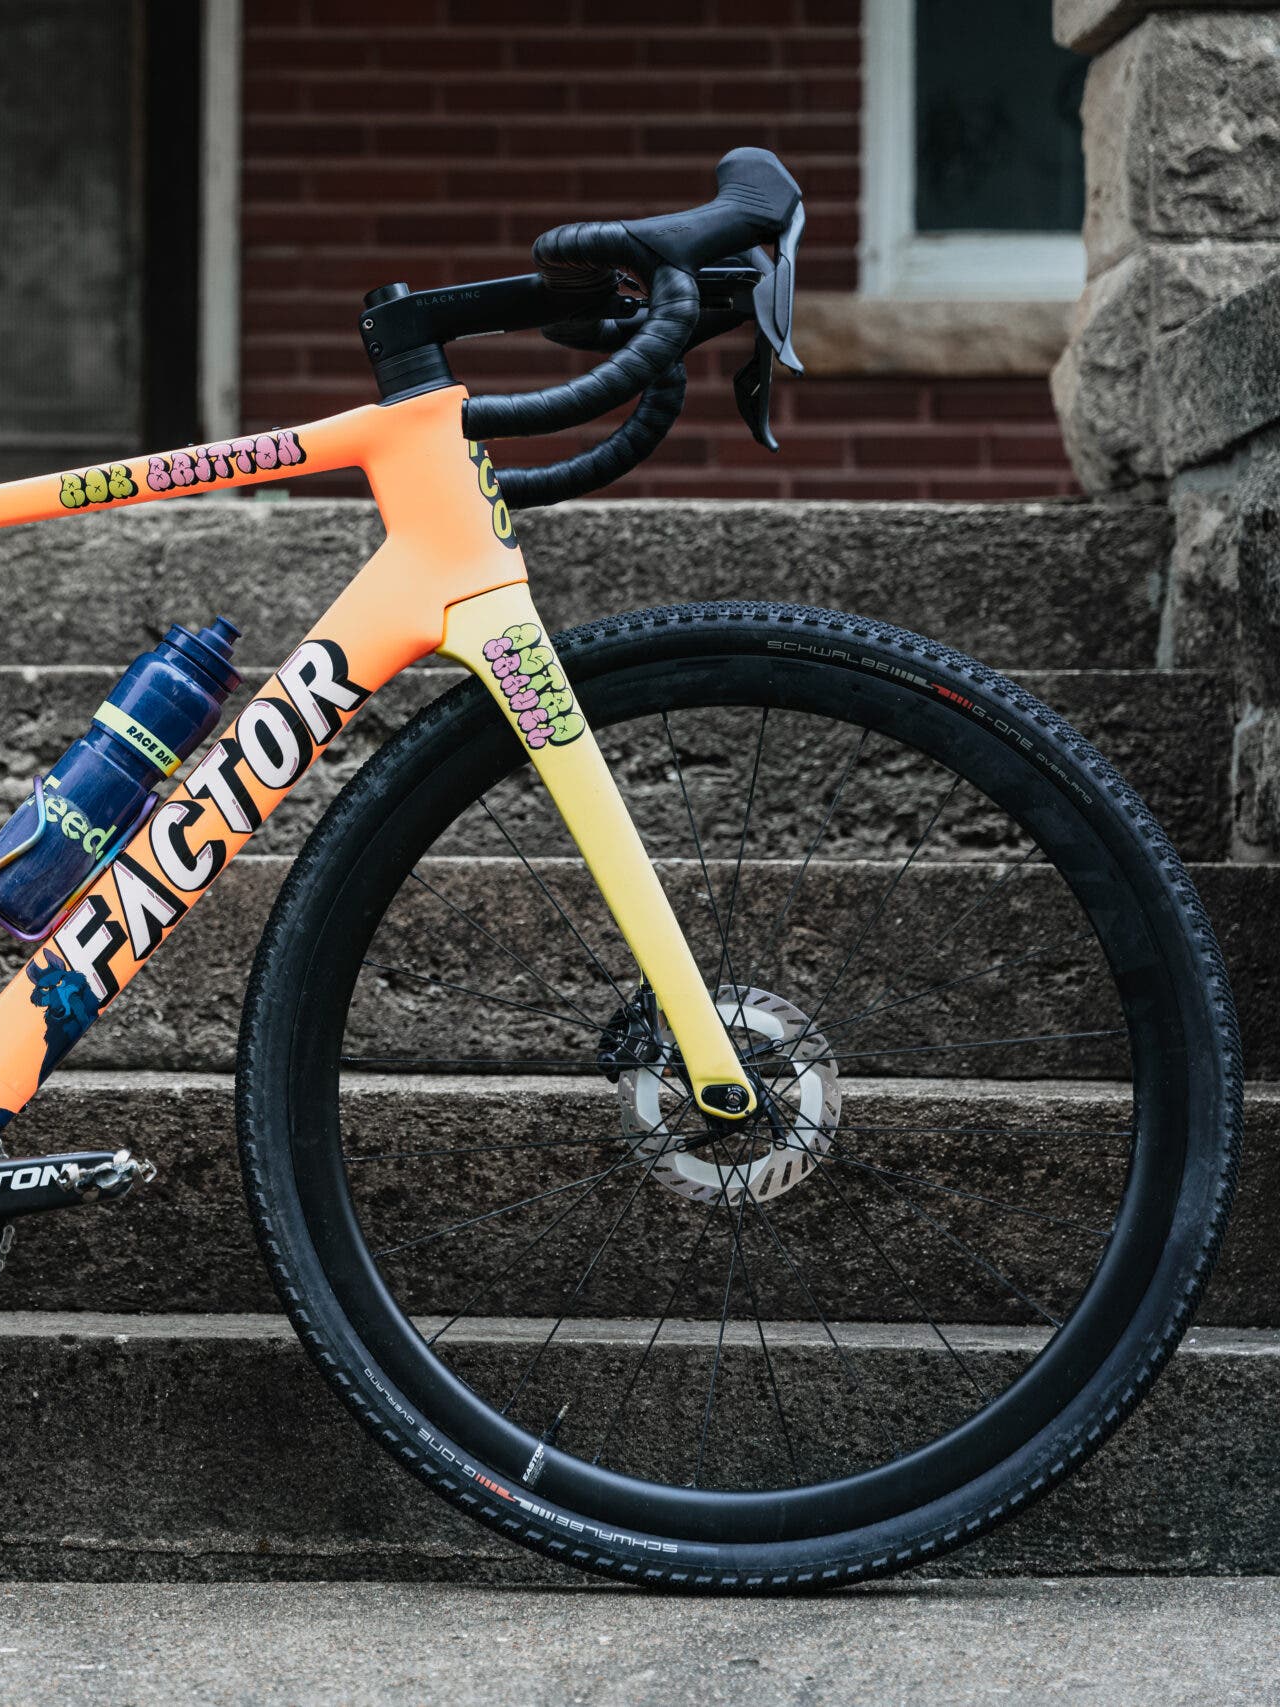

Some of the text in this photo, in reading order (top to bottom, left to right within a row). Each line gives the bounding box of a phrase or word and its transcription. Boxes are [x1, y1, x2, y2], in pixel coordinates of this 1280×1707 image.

[416, 290, 481, 307] BLACK INC
[766, 639, 1093, 805] SCHWALBE G-ONE OVERLAND
[126, 725, 175, 767] RACE DAY
[53, 639, 370, 1007] FACTOR
[363, 1367, 416, 1426] OVERLAND
[417, 1429, 478, 1479] G-ONE
[521, 1442, 545, 1483] EASTON
[555, 1511, 680, 1553] SCHWALBE
